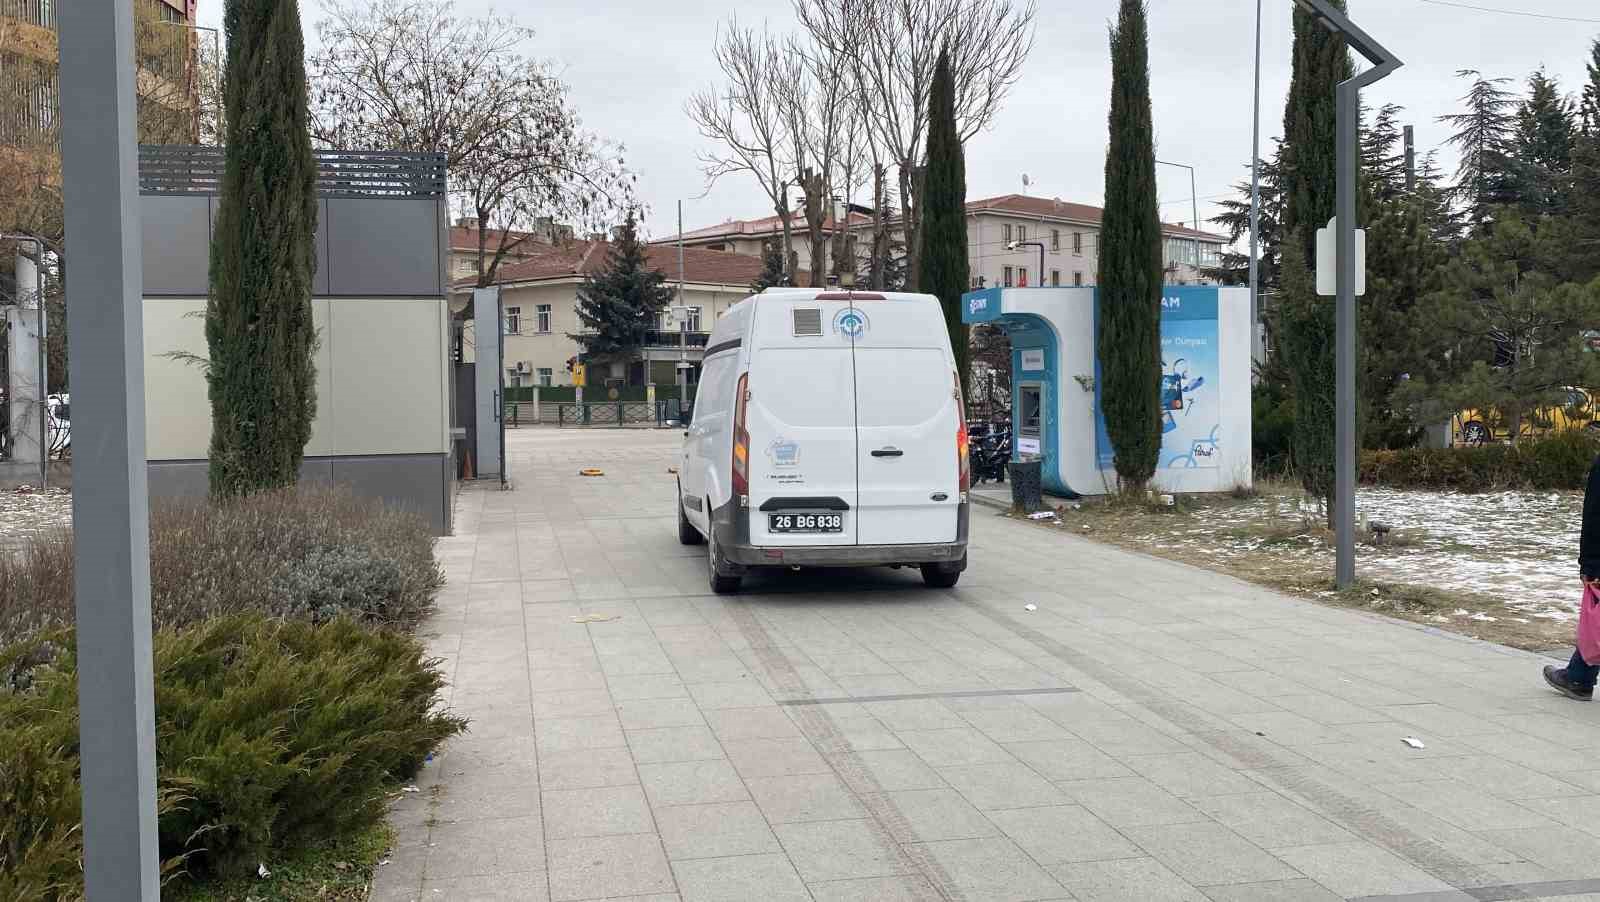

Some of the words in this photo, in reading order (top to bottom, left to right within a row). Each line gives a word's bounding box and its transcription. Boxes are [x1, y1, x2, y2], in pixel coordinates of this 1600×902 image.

[1160, 296, 1180, 308] AM
[775, 515, 791, 528] 26
[796, 515, 815, 528] BG
[817, 515, 841, 528] 838
